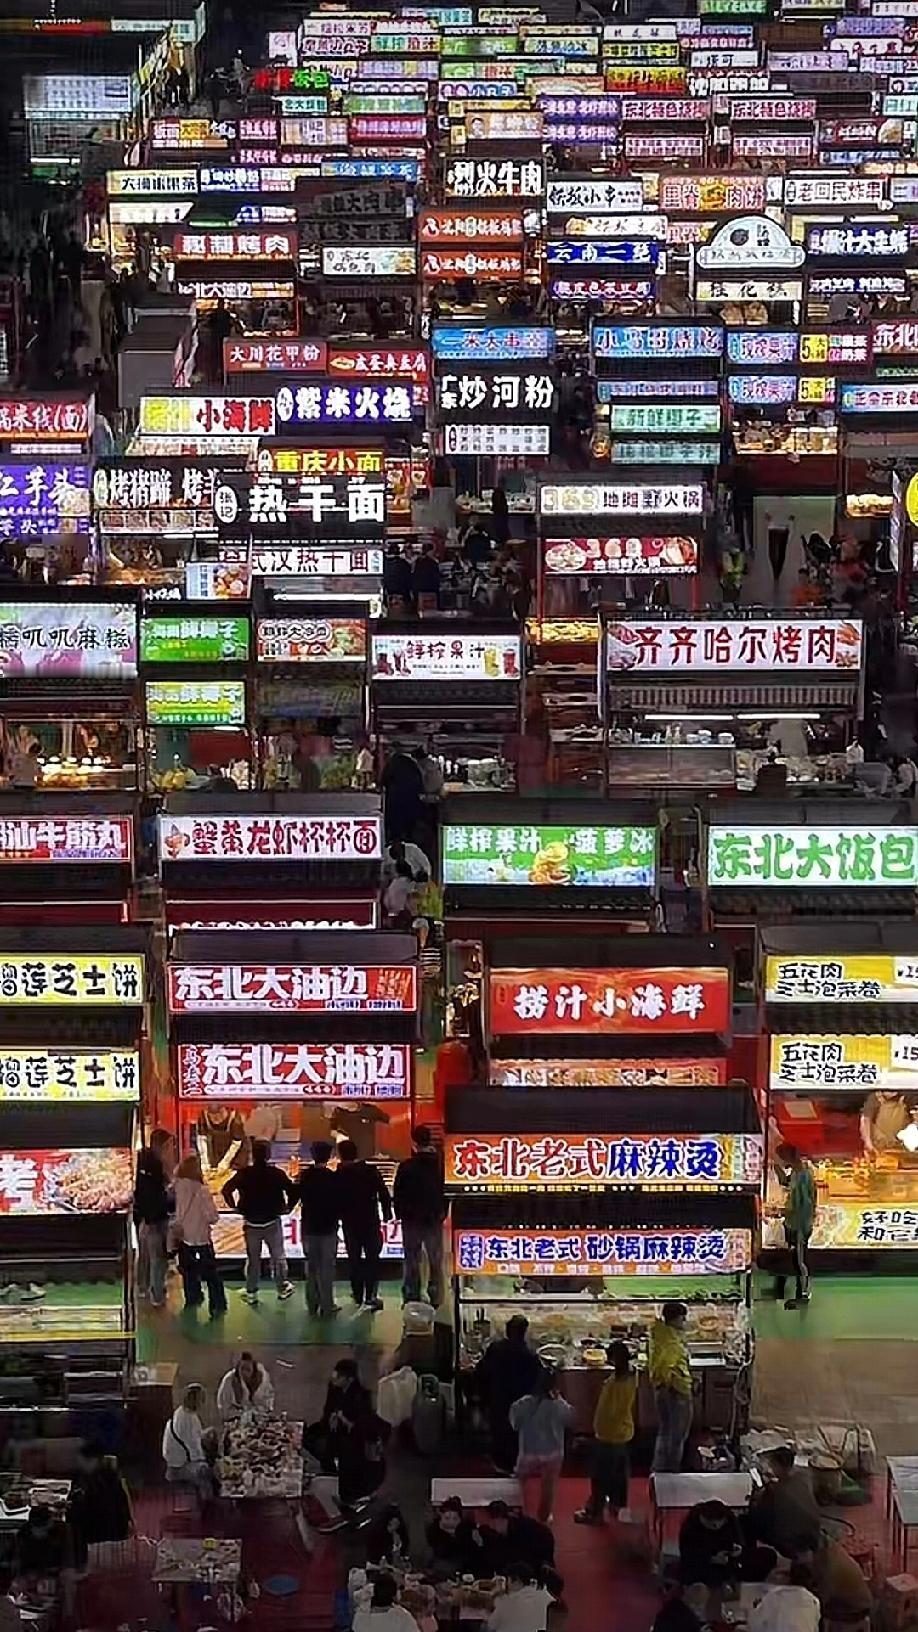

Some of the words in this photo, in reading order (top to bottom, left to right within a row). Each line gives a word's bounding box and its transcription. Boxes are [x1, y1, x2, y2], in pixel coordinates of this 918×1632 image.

[453, 161, 542, 196] 烈火牛肉
[554, 242, 650, 261] 云南一绝
[274, 451, 383, 472] 重庆小面
[249, 484, 386, 523] 热干面
[407, 640, 485, 660] 鲜榨果汁
[635, 625, 836, 664] 齐齐哈尔烤肉
[0, 820, 126, 849] 汕牛筋丸
[191, 820, 378, 856] 蟹黄龙虾杯杯面
[445, 826, 540, 854] 鲜榨果汁
[574, 826, 654, 855] 菠萝冰
[712, 832, 917, 881] 东北大饭包
[175, 966, 369, 1000] 东北大油边
[778, 962, 842, 979] 五花肉
[513, 984, 705, 1020] 捞汁小海鲜
[777, 980, 881, 999] 芝士泡菜卷
[203, 1045, 405, 1084] 东北大油边
[781, 1043, 842, 1063] 五花肉
[0, 1056, 137, 1089] 榴莲芝士饼
[779, 1063, 878, 1084] 芝士泡菜卷
[456, 1139, 721, 1177] 东北老式麻辣烫
[488, 1234, 726, 1261] 东北老式砂锅麻辣烫
